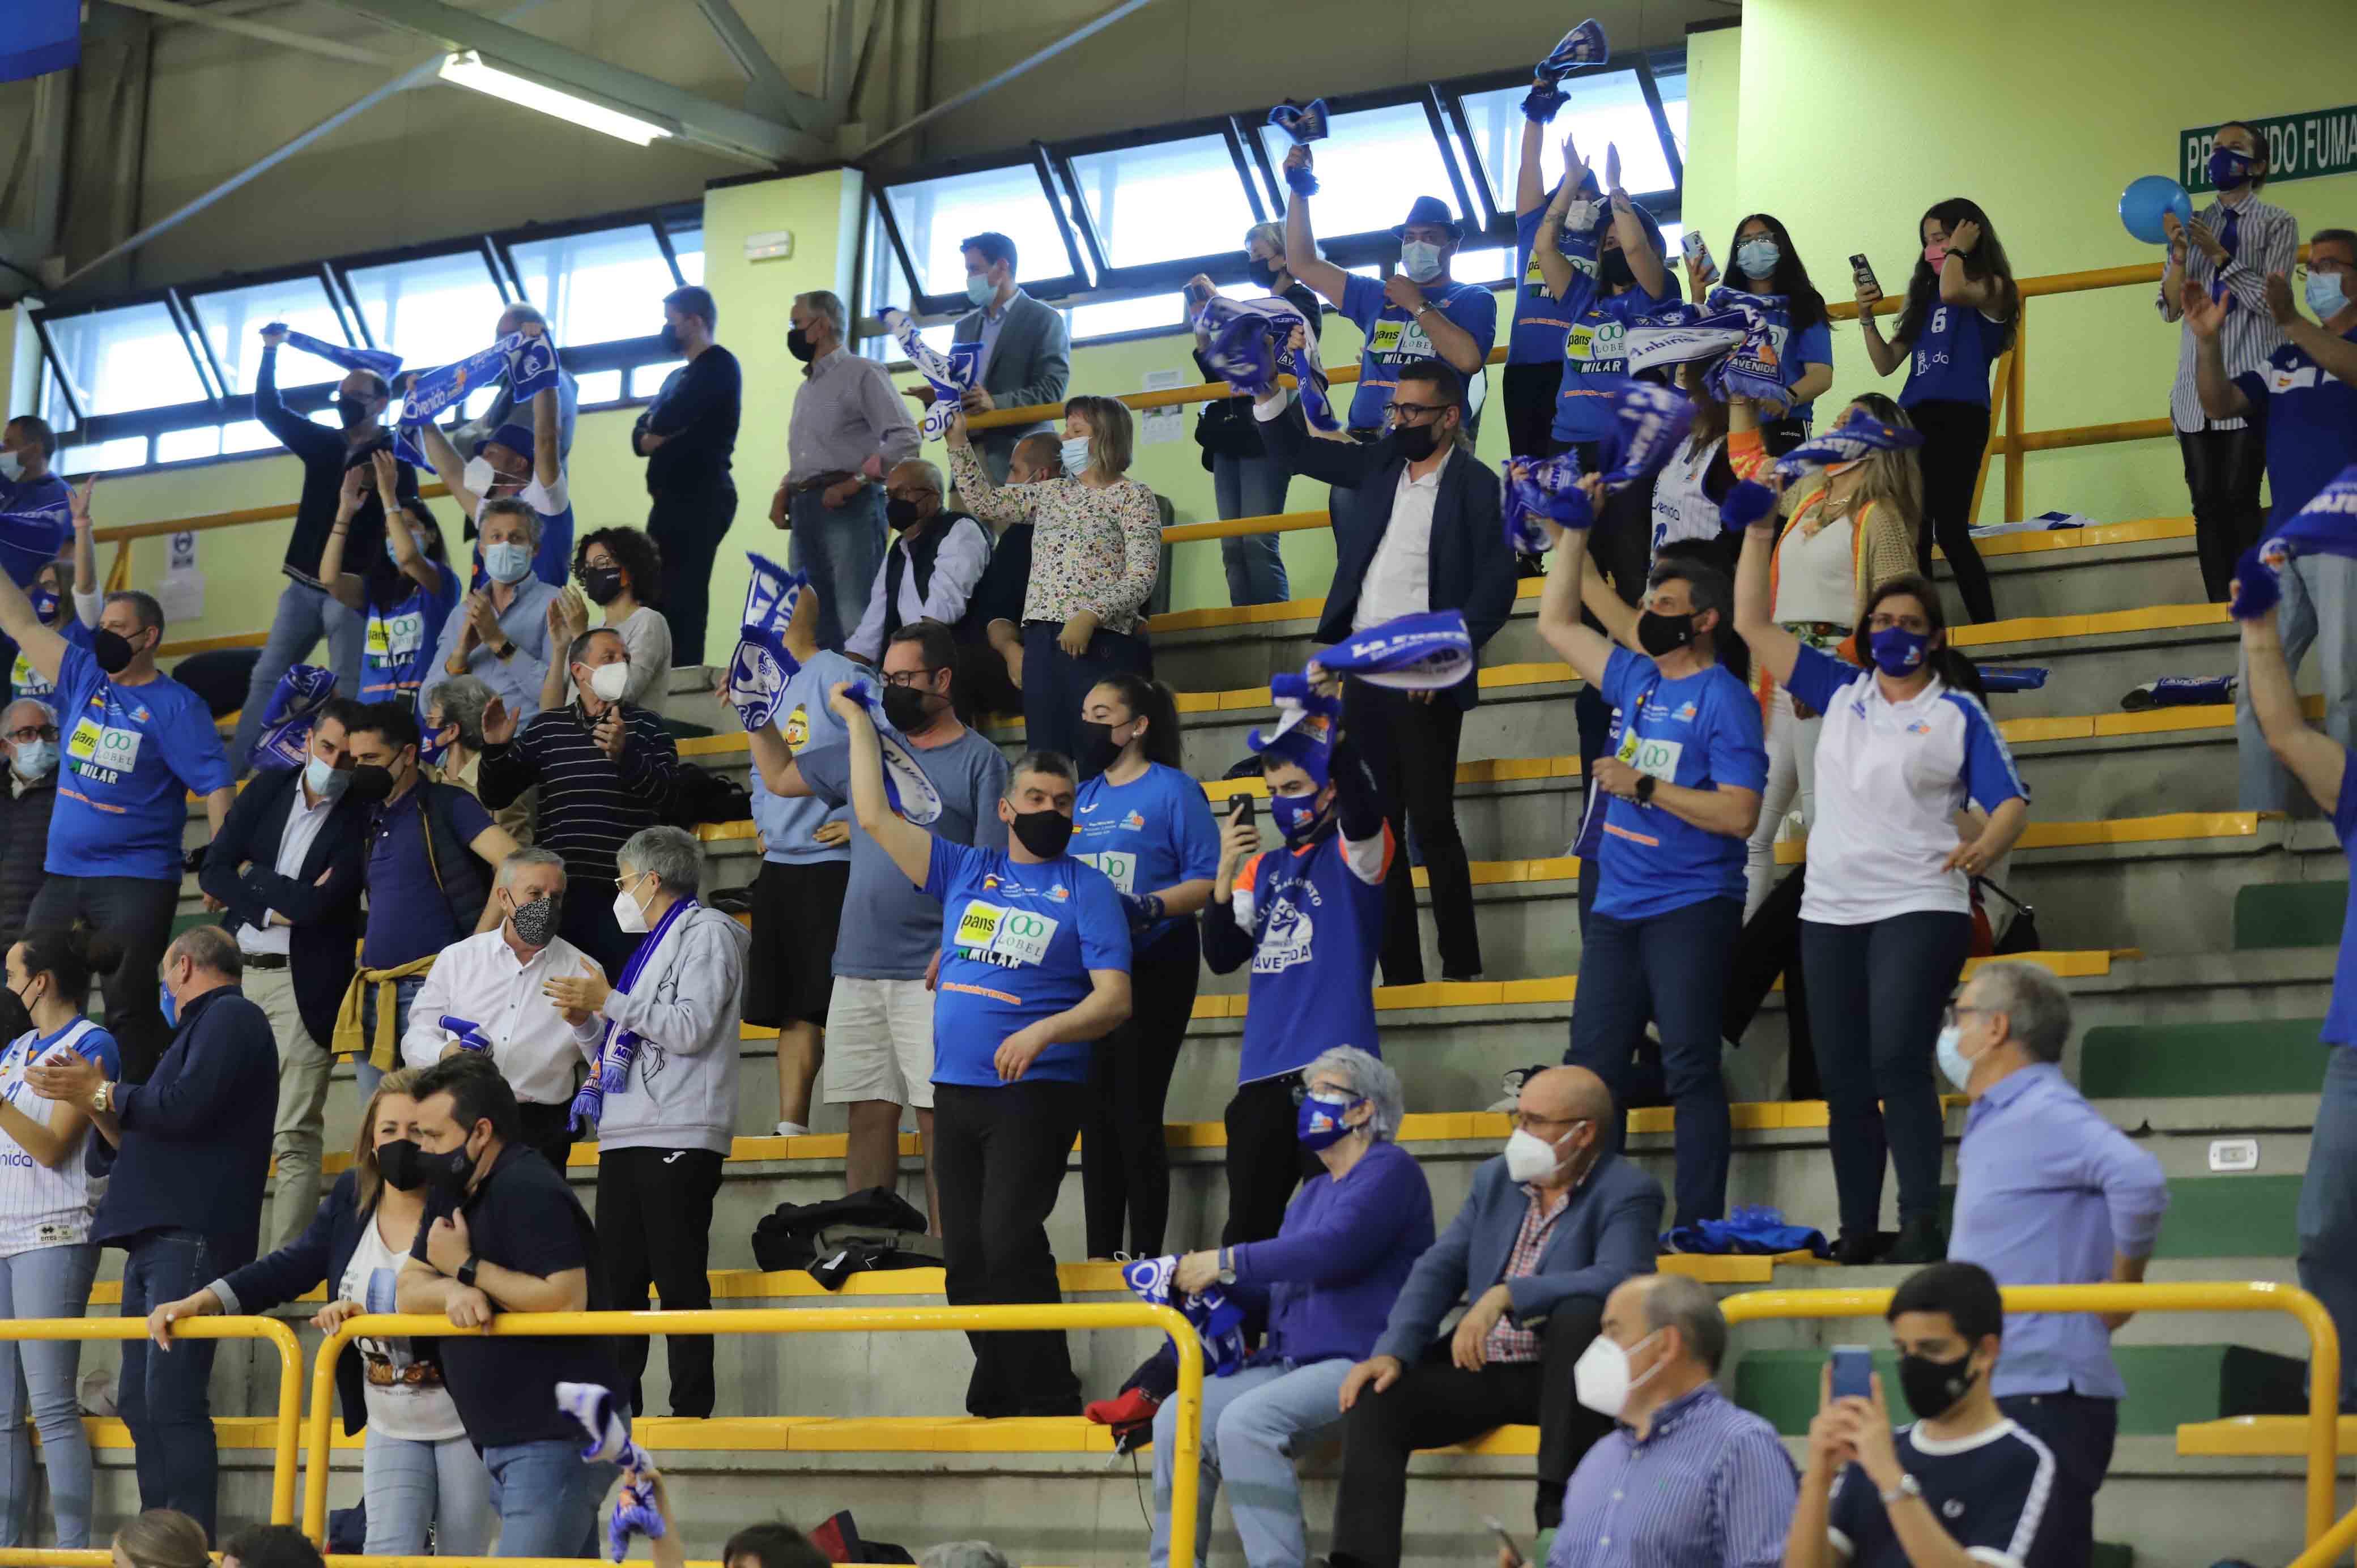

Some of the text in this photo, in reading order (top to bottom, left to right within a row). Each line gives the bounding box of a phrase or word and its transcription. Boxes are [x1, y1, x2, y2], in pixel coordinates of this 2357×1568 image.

[1931, 306, 1947, 333] 6
[1374, 330, 1399, 343] pans
[1567, 334, 1591, 347] pans
[1596, 343, 1624, 353] LOBE
[1581, 360, 1622, 373] MILAR
[1730, 357, 1777, 374] AVENIDA
[71, 730, 97, 748] pans
[97, 752, 133, 766] LOBEL
[79, 762, 118, 785] MILAR
[961, 914, 995, 932] pans
[997, 936, 1041, 957] LOBEL
